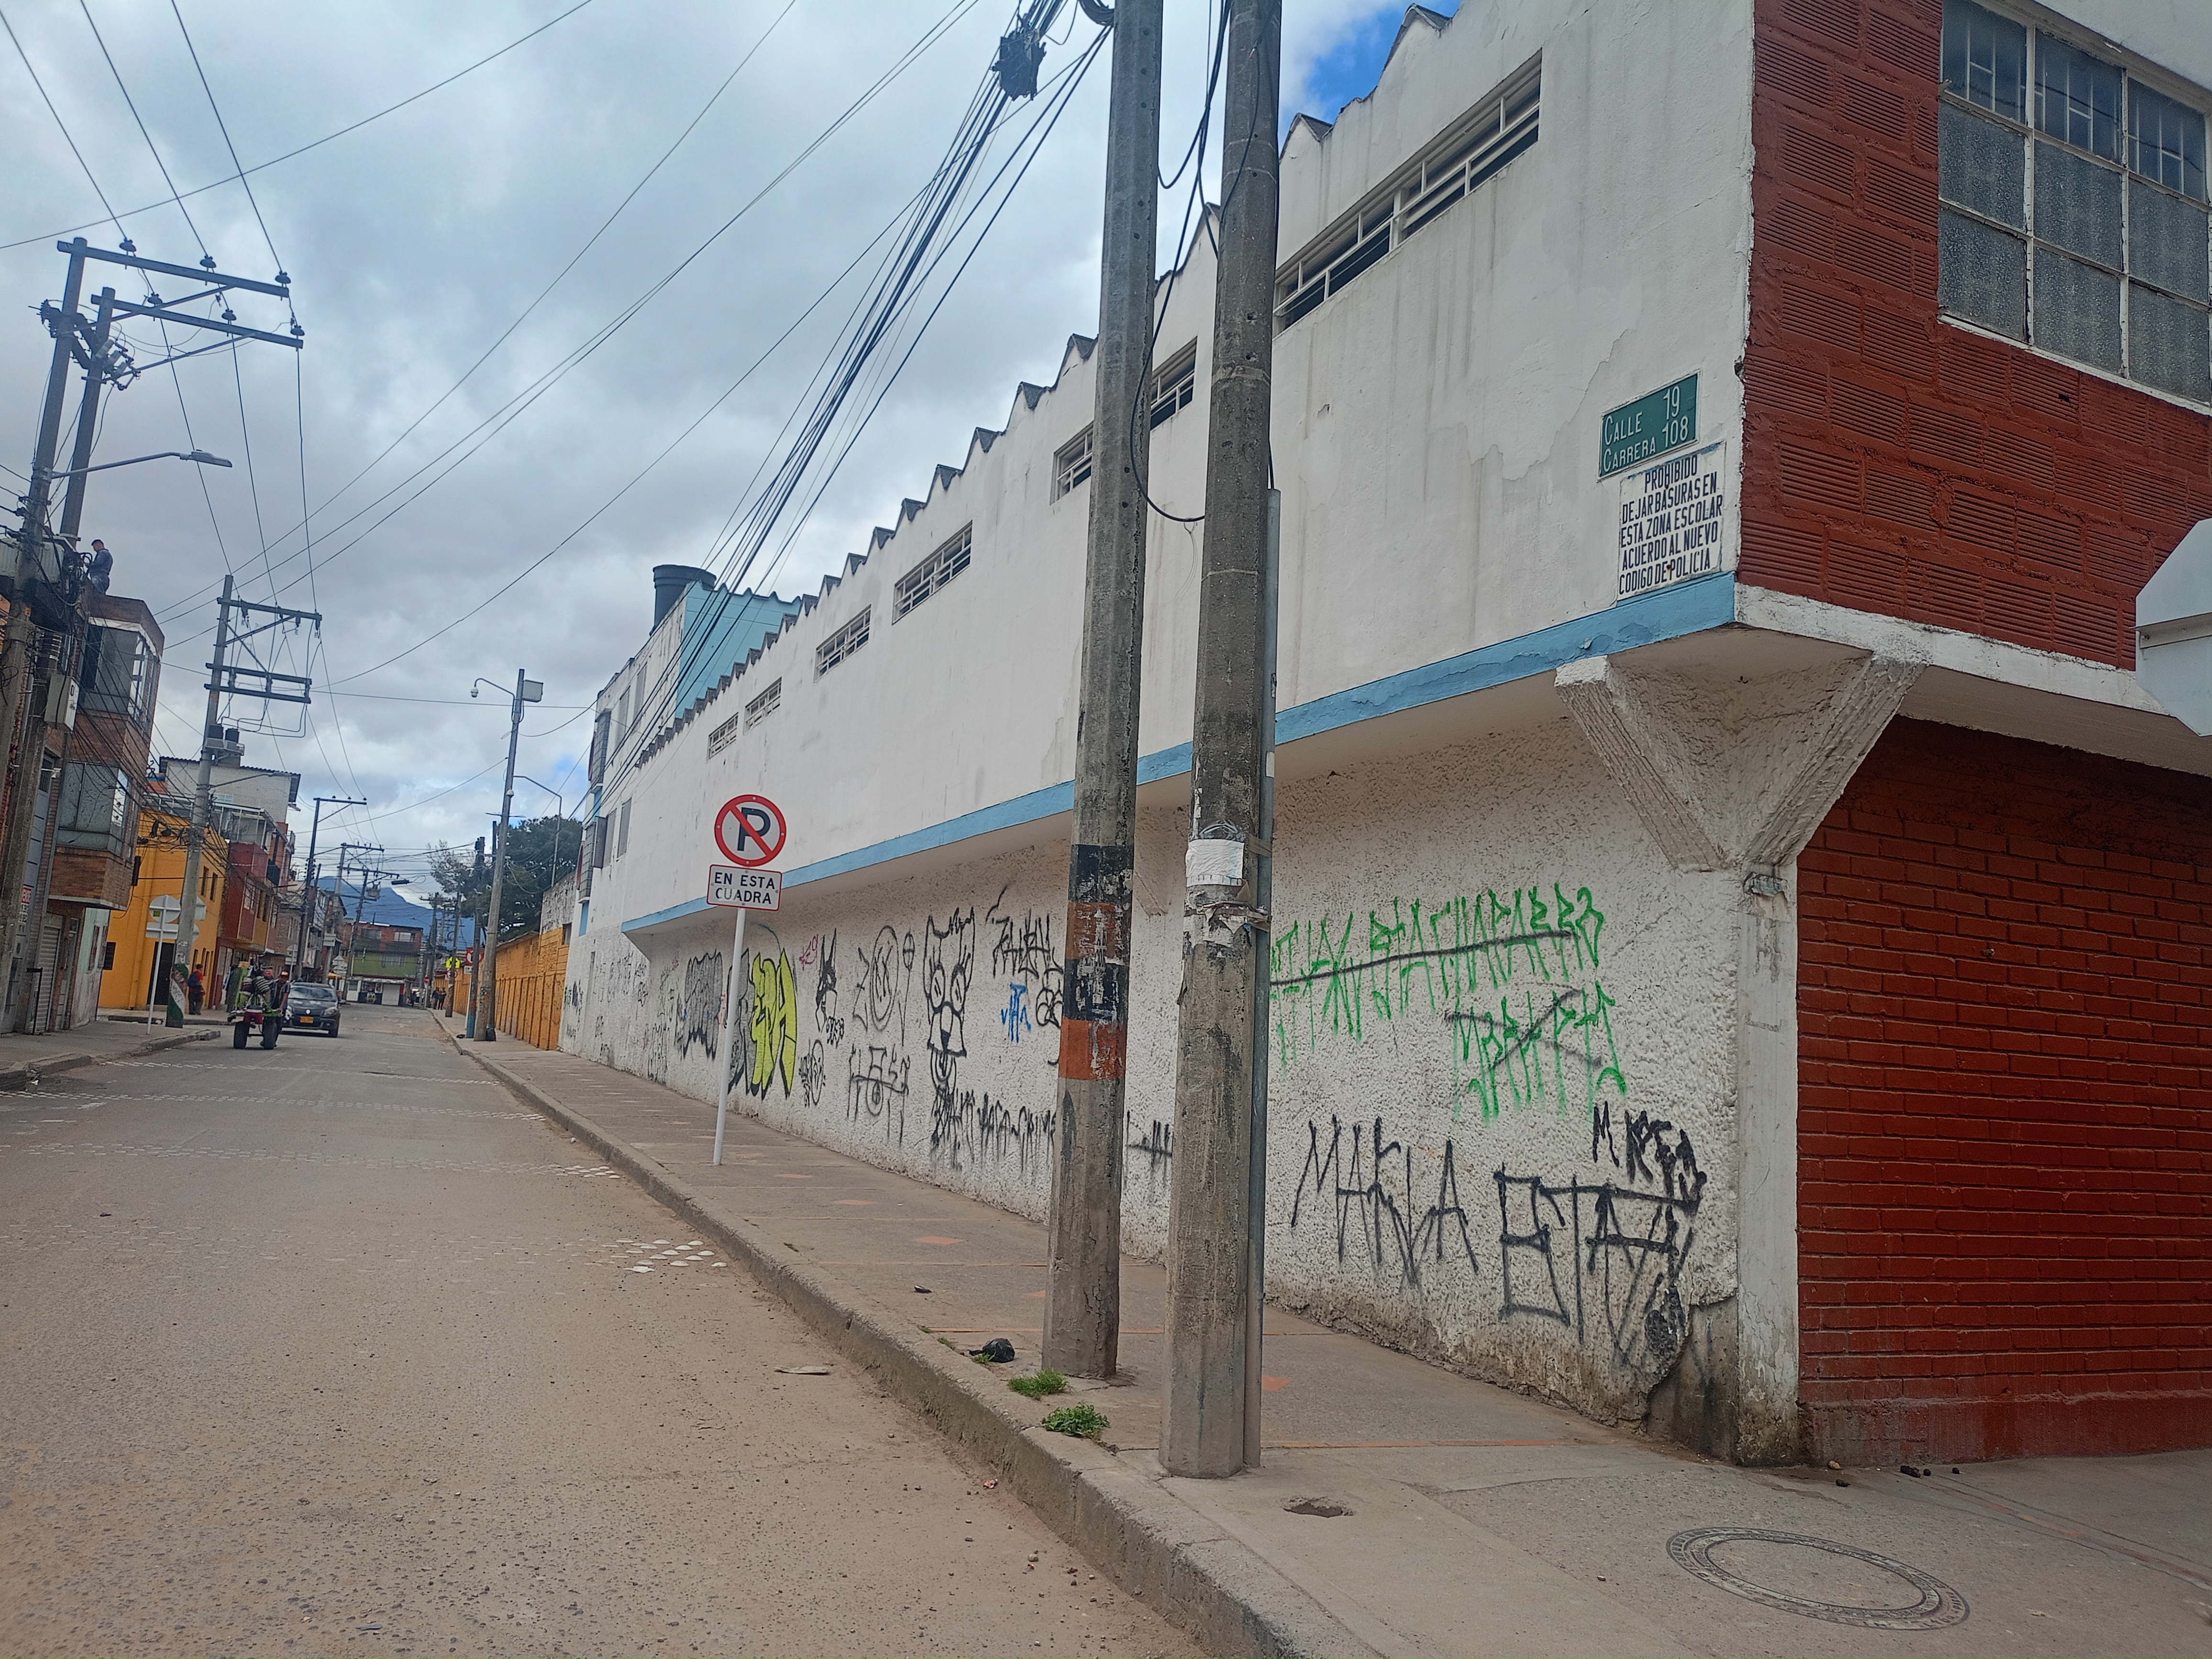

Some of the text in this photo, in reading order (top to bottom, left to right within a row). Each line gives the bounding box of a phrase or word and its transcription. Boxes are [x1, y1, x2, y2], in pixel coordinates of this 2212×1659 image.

[1604, 386, 1680, 445] CALLE 19
[1604, 416, 1689, 472] CARRERA 108
[1622, 471, 1717, 524] DEJAR BASURAS EN
[1645, 454, 1698, 493] PROHIBIDO
[1621, 494, 1723, 548] ESTA ZONA ESCOLAR
[1622, 520, 1718, 571] ACUERDO AL NUEVO
[1619, 548, 1710, 595] CODIGO DE POLICIA
[714, 872, 775, 890] EN ESTA
[715, 887, 772, 905] CUADRA
